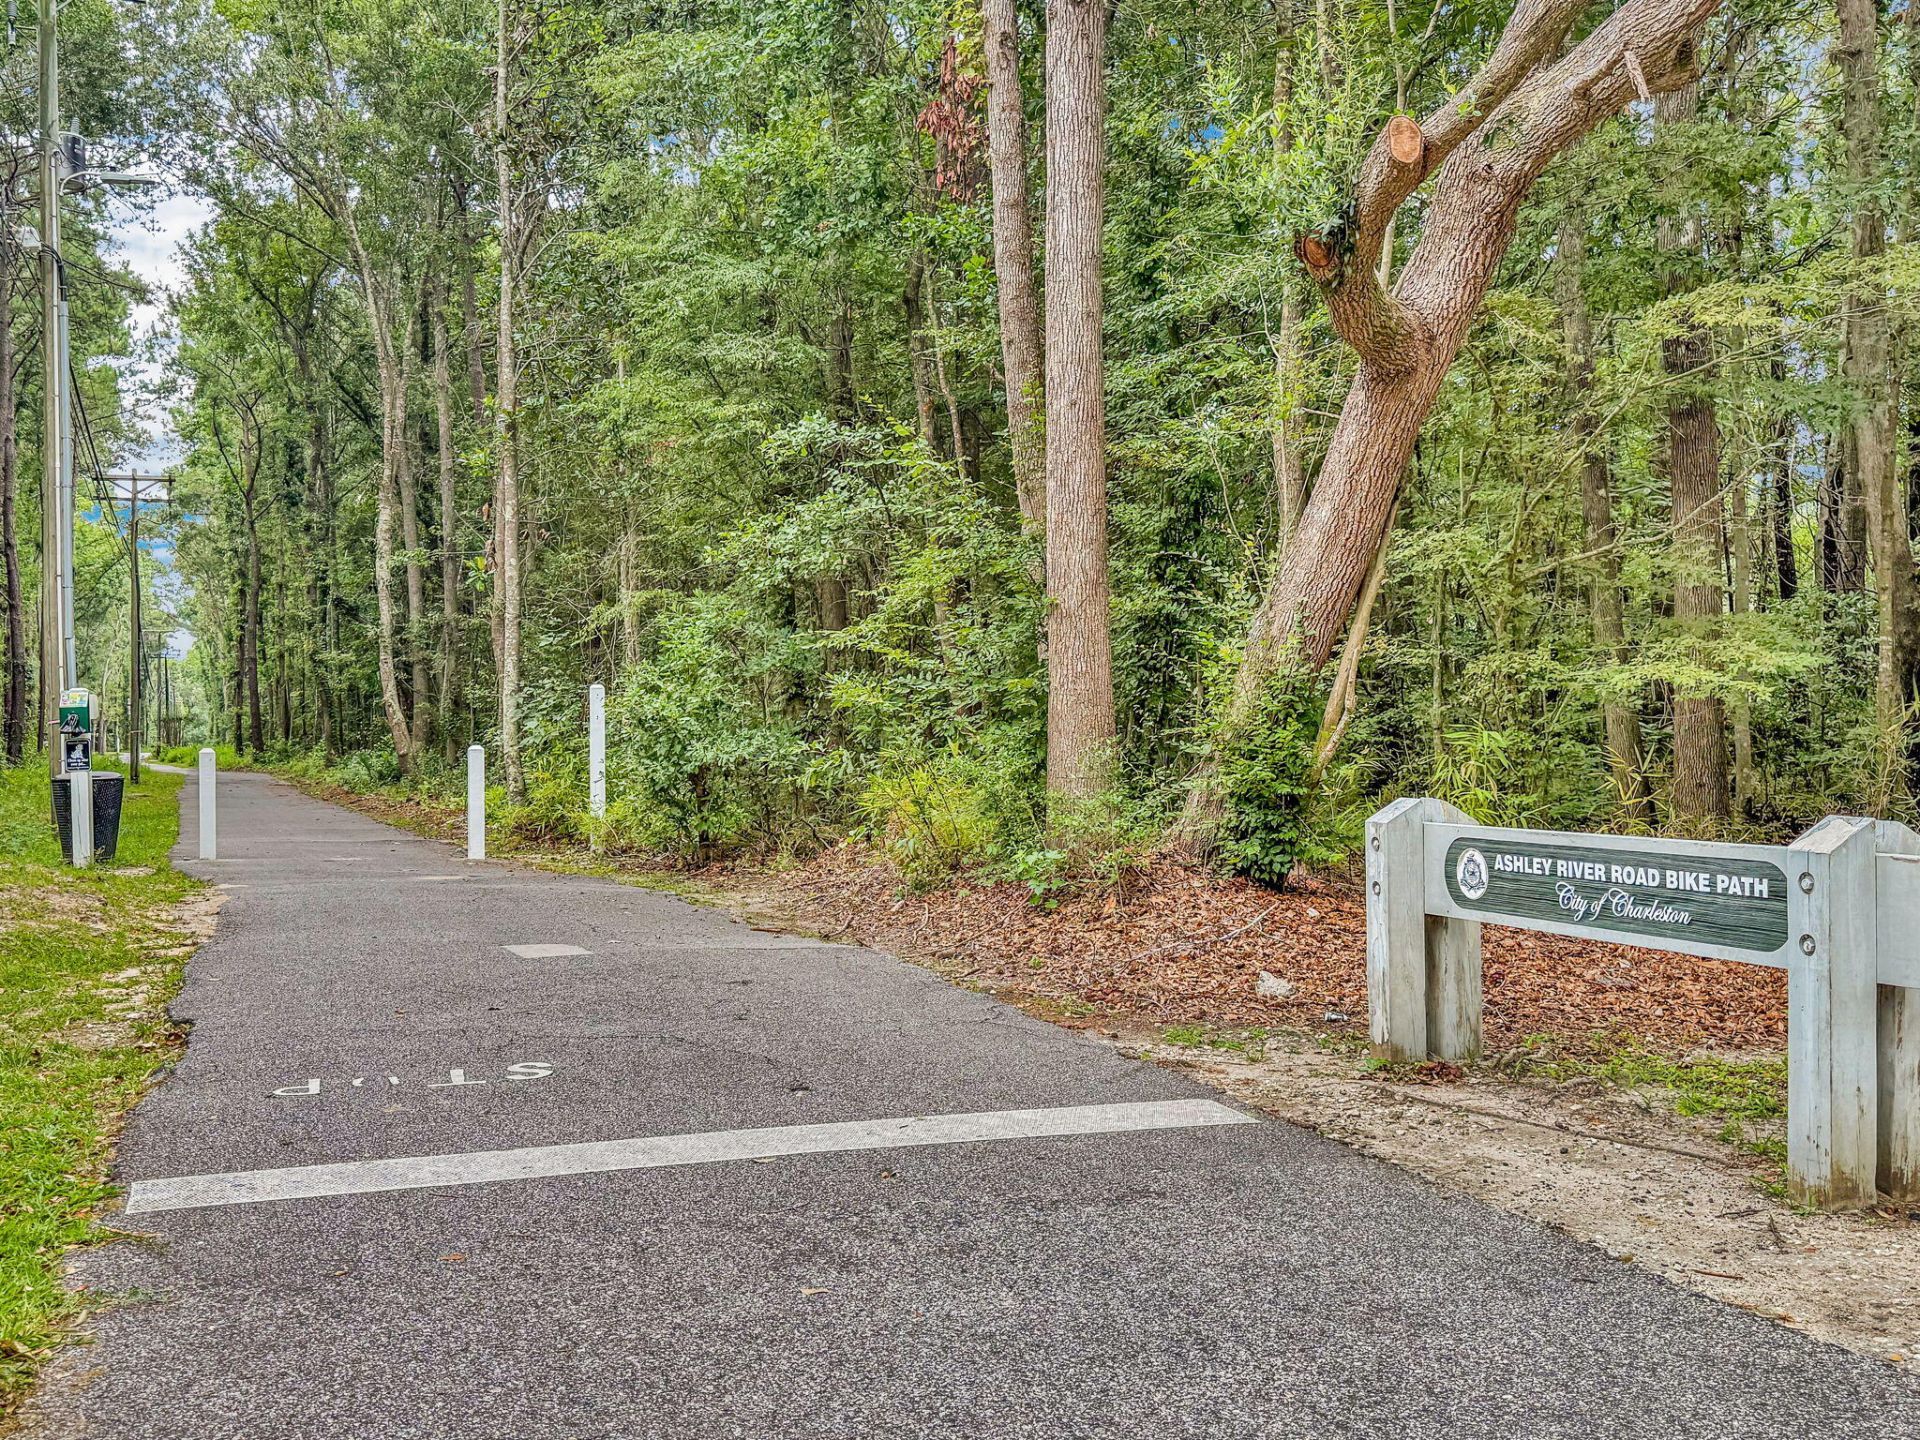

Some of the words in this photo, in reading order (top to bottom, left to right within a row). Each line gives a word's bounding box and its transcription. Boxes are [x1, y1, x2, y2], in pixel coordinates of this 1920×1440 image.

[1494, 854, 1551, 876] ASHLEY
[1556, 861, 1606, 882] RIVER
[1610, 865, 1660, 887] ROAD
[1665, 870, 1710, 893] BIKE
[1716, 877, 1768, 898] PATH
[1555, 882, 1588, 921] City
[1589, 890, 1607, 920] of
[1608, 888, 1692, 925] Charleston
[272, 1061, 553, 1096] STP
